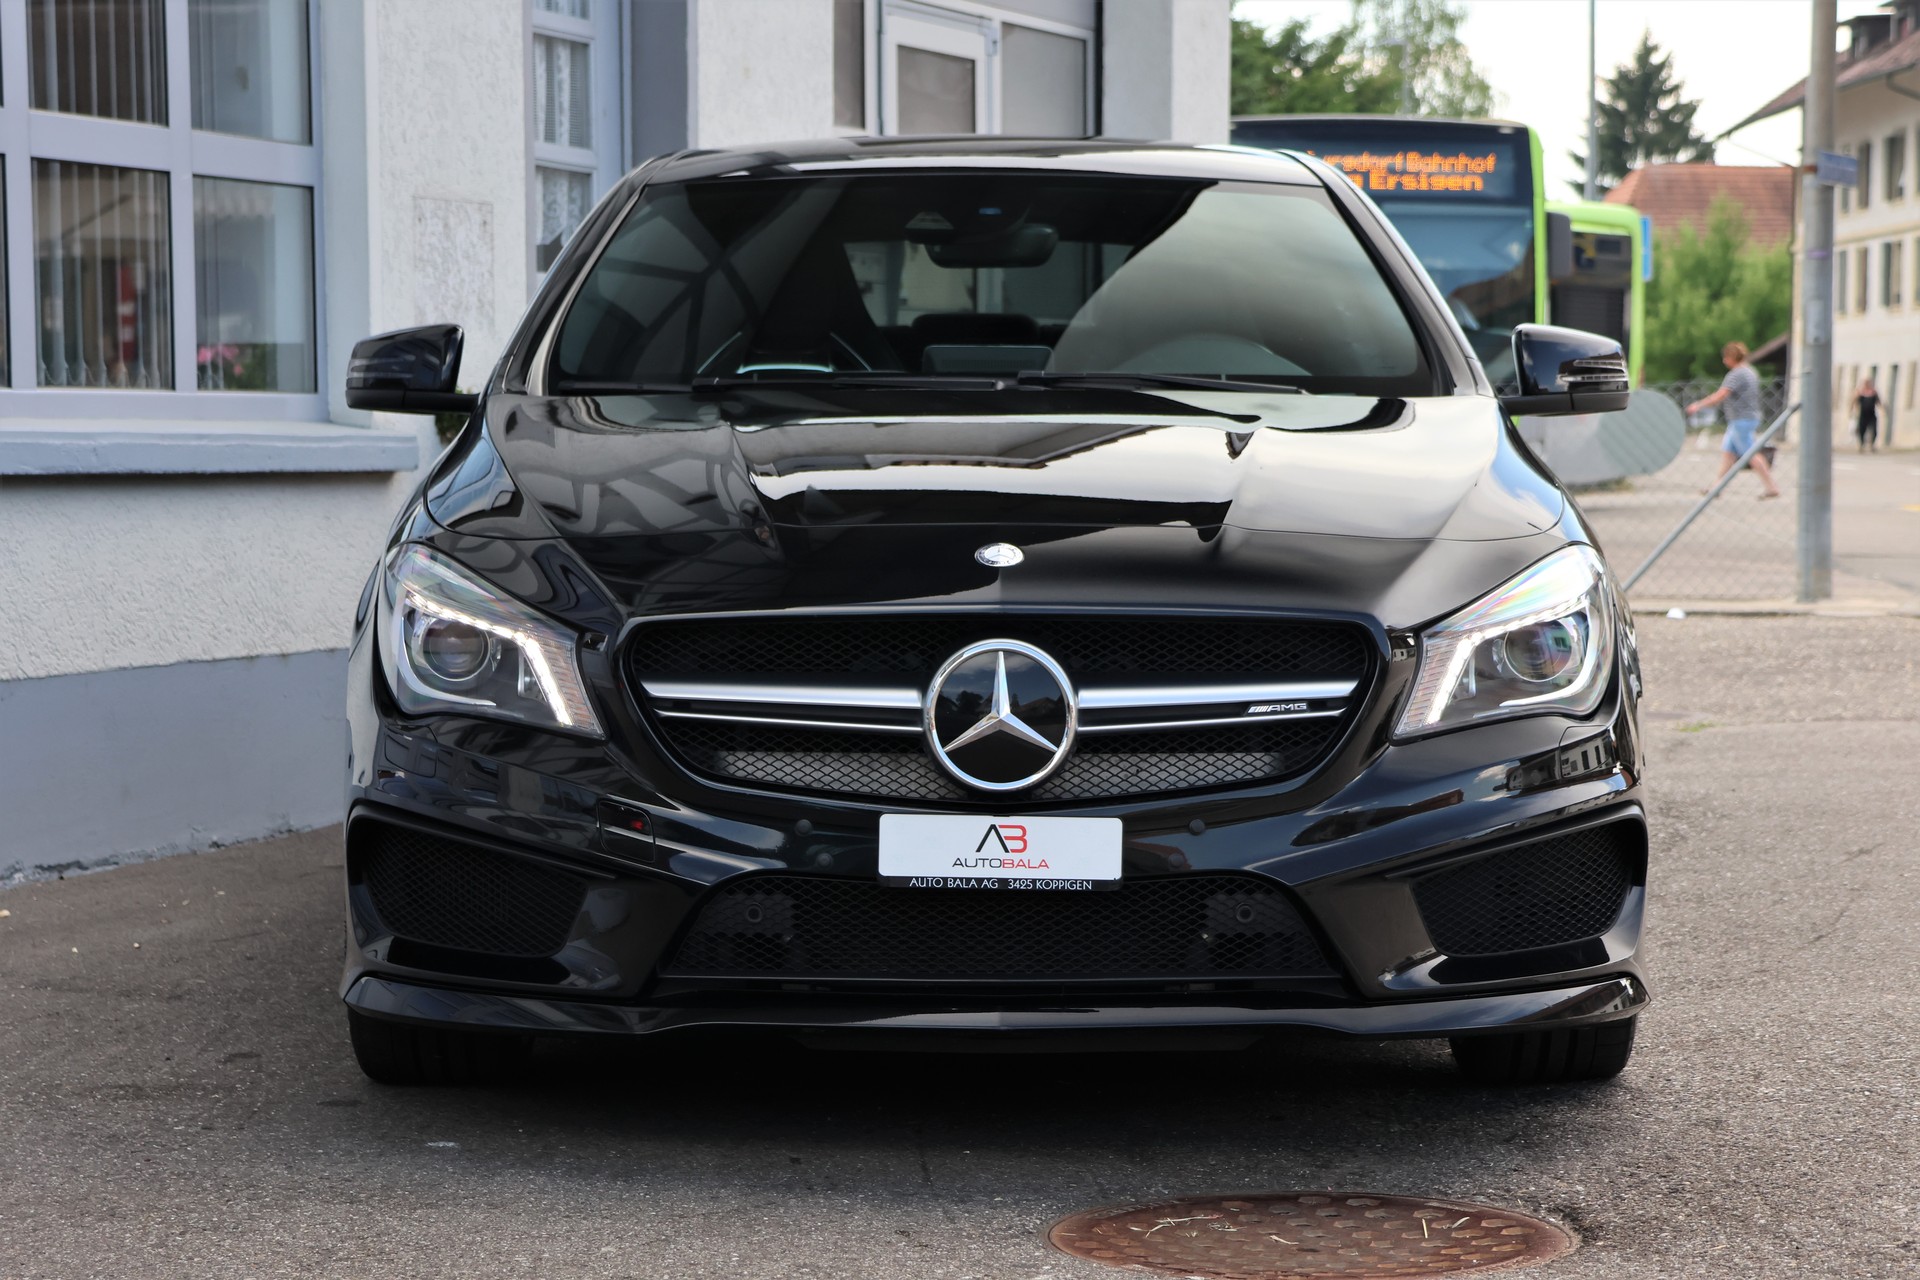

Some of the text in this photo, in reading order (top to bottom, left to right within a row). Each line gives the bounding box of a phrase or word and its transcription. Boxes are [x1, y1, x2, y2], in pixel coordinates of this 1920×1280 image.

[1406, 151, 1496, 173] Bahnhof
[1266, 703, 1307, 713] AMG
[909, 877, 1092, 890] AUTO BALA AG 3425 KOPPIGEN
